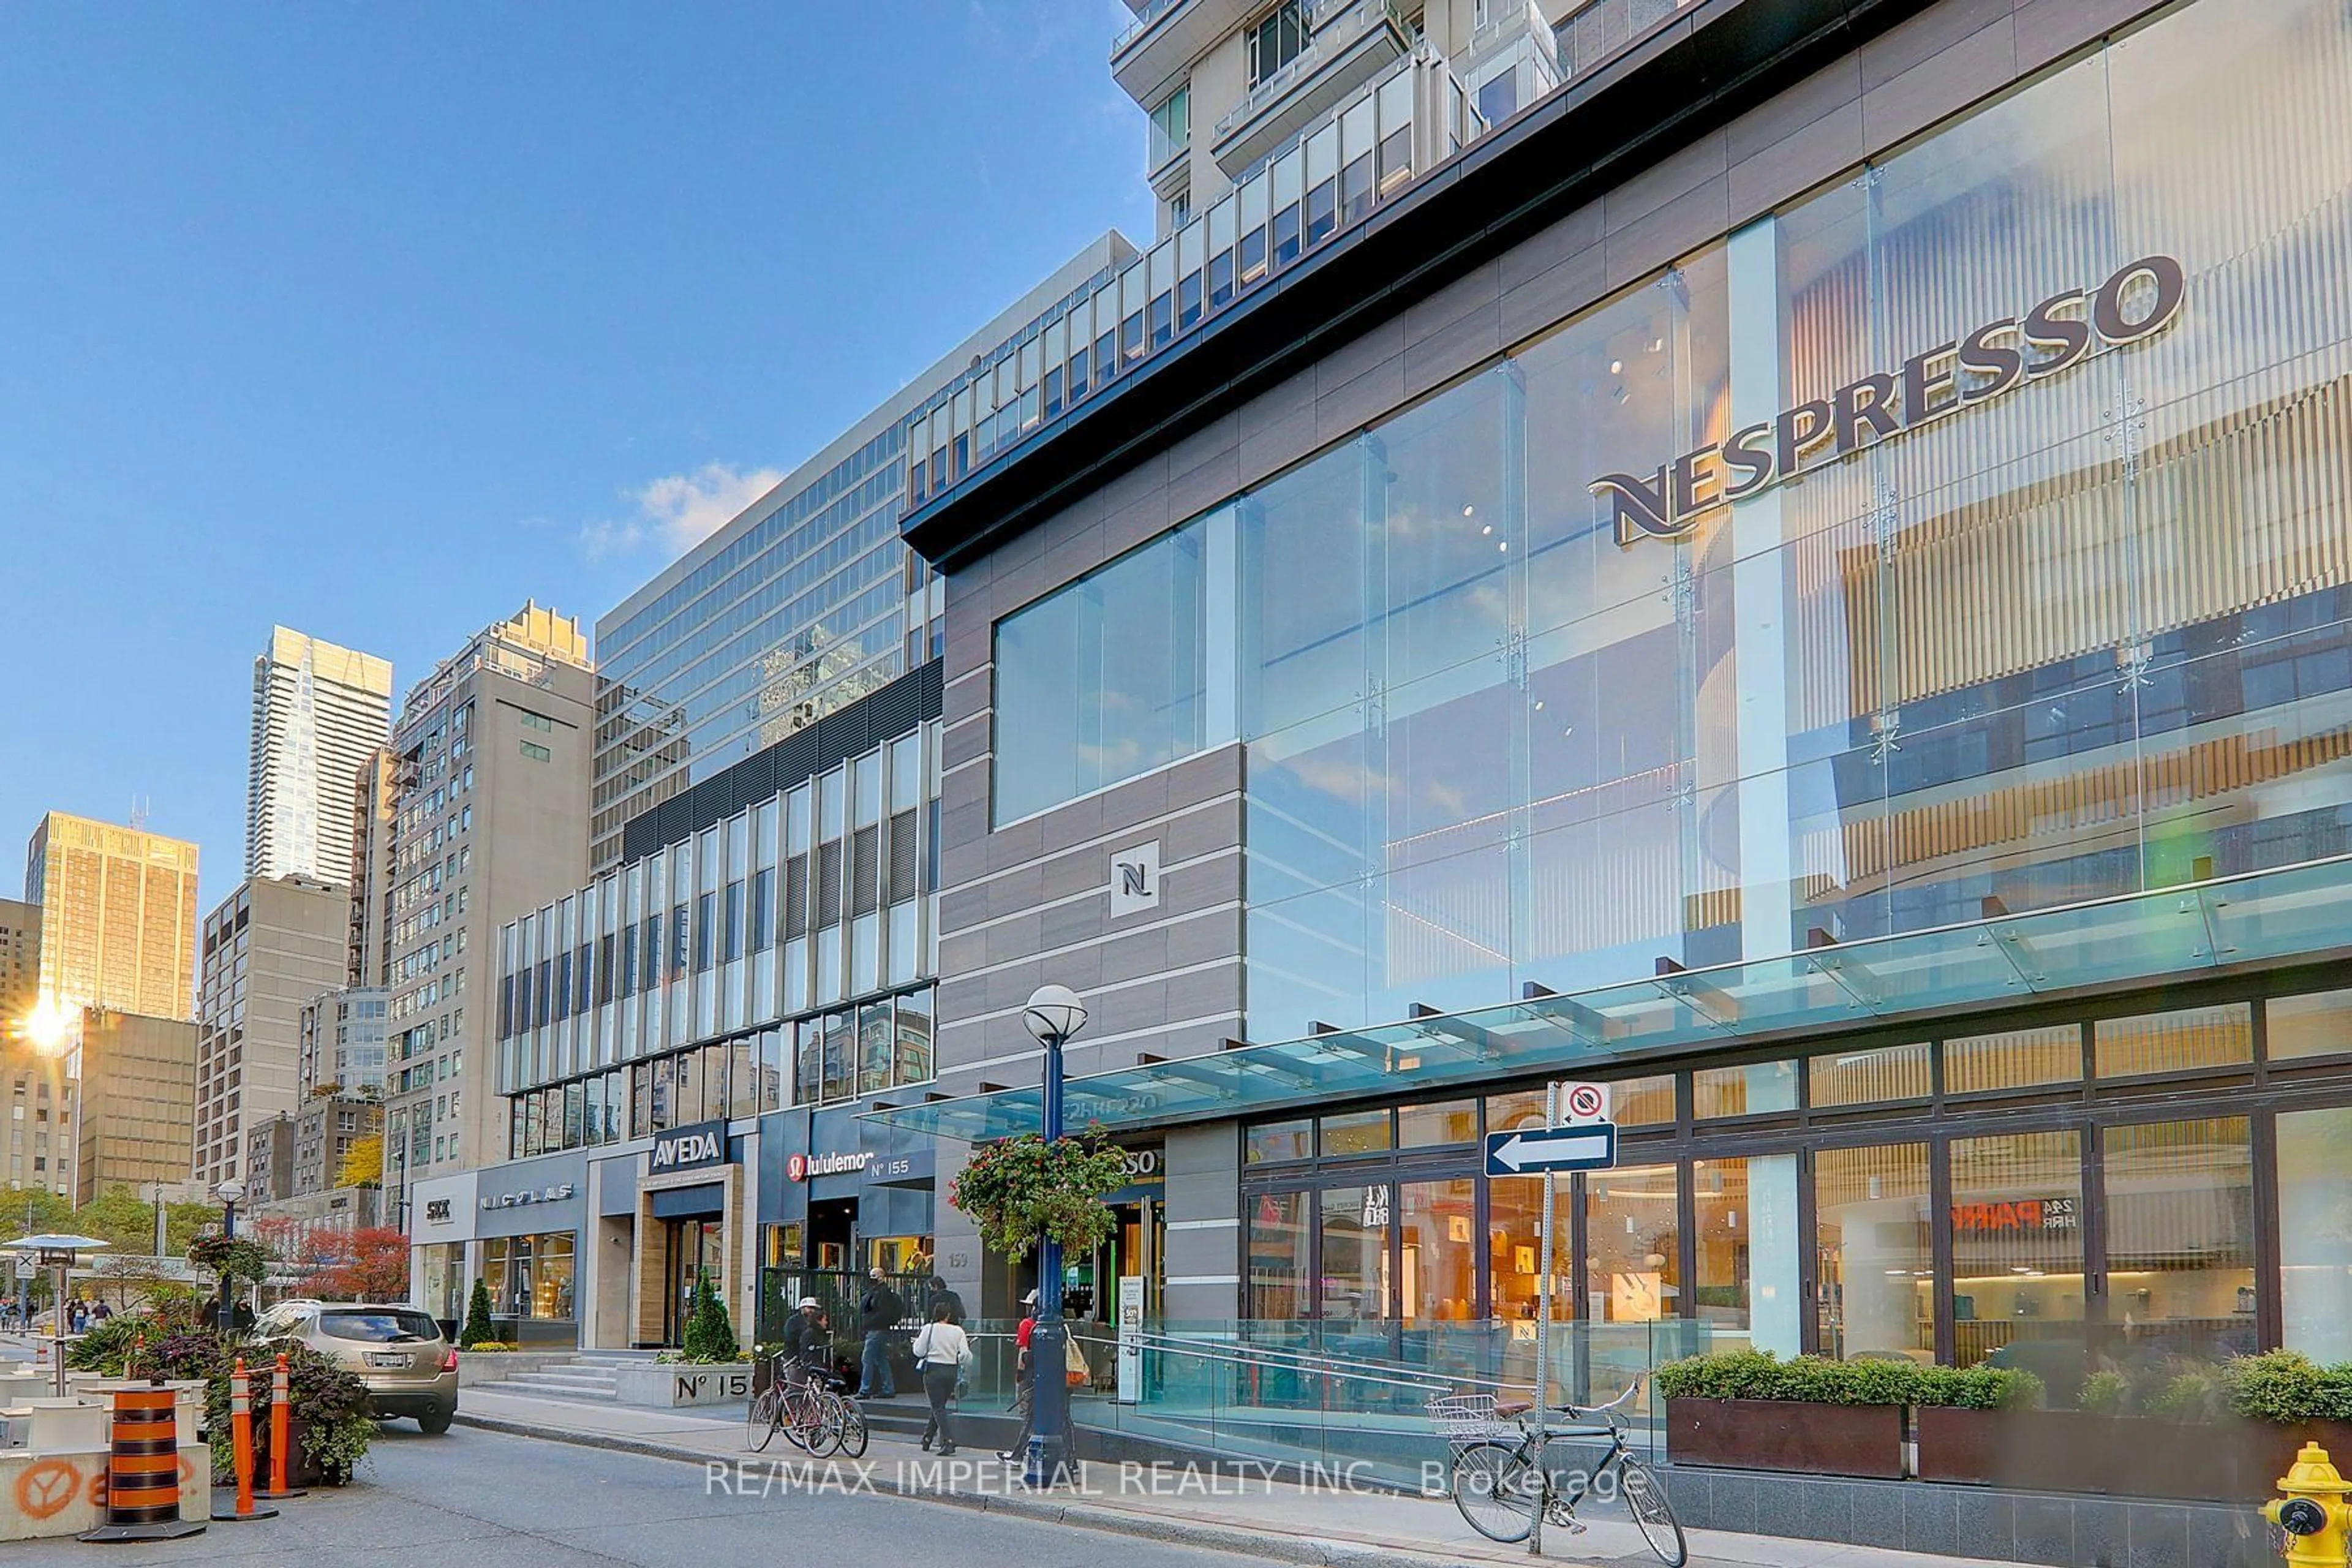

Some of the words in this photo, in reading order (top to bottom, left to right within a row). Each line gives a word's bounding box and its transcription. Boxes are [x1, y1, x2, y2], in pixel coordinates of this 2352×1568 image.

[1588, 254, 2185, 545] NESPRESSO
[654, 1132, 720, 1167] AVEDA
[888, 1160, 909, 1175] 155
[720, 1376, 755, 1397] 15
